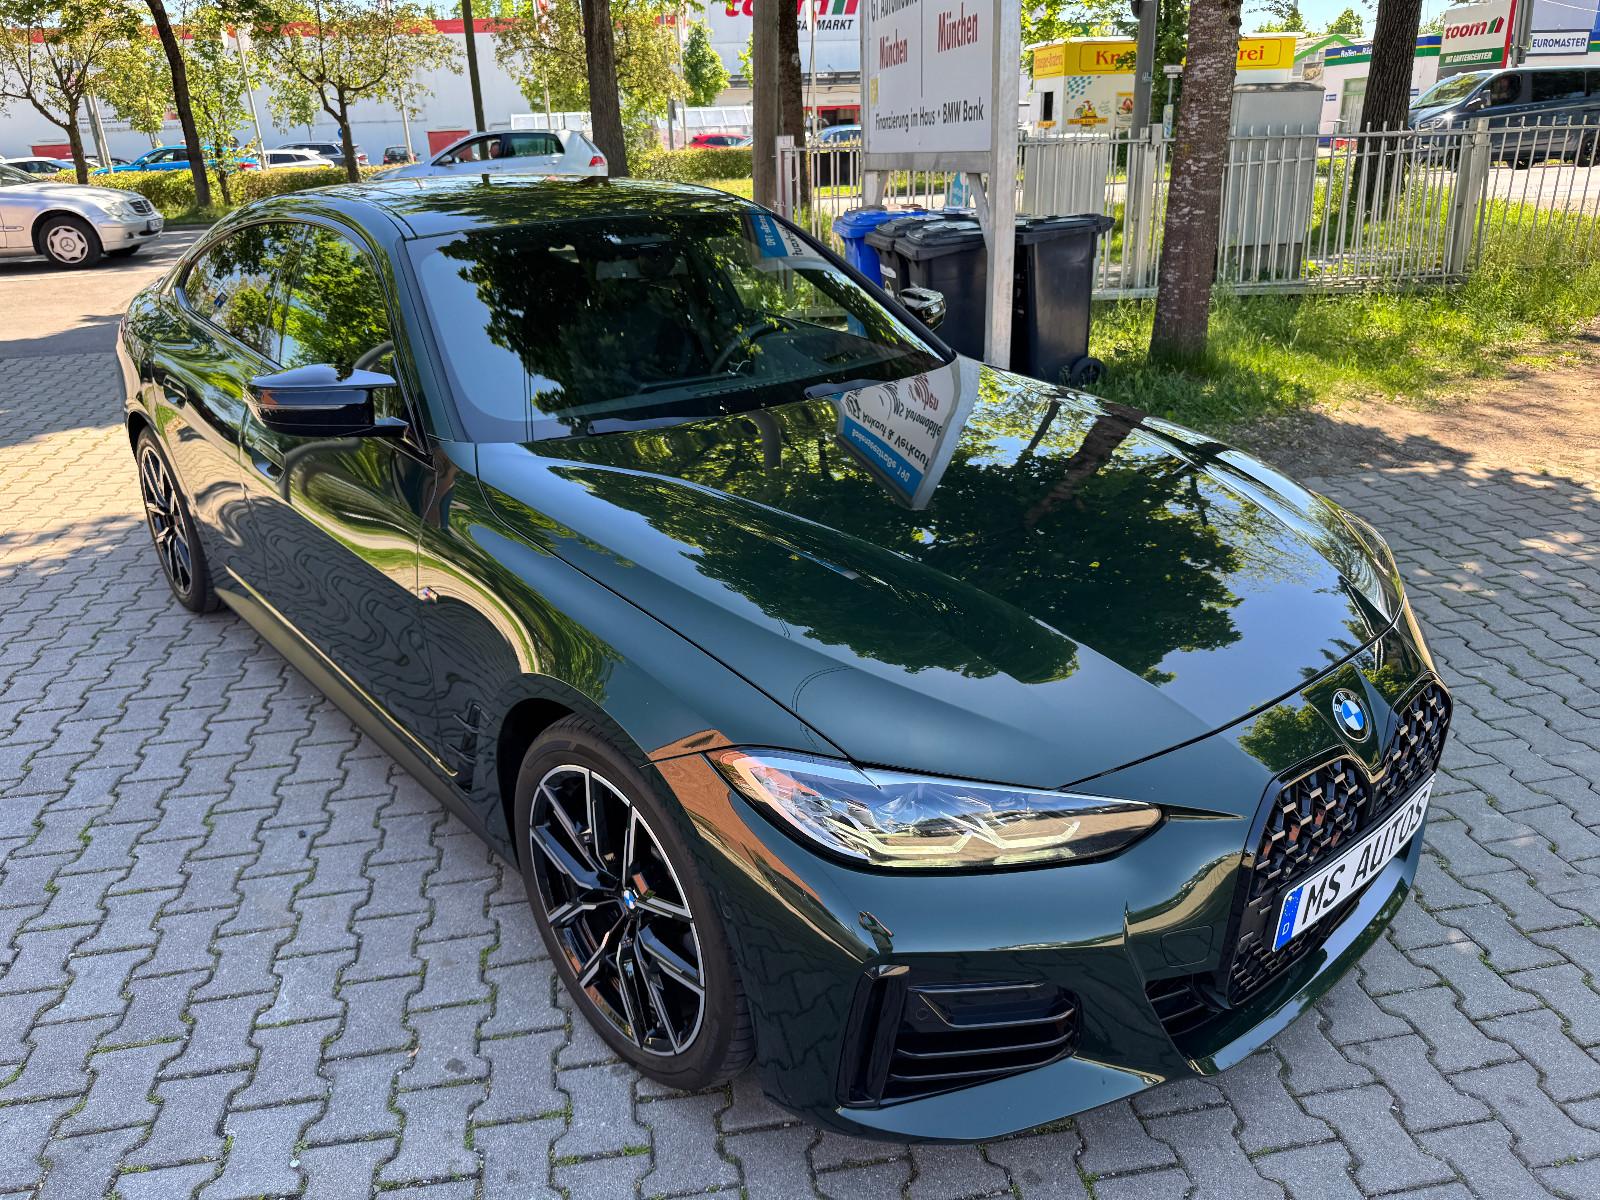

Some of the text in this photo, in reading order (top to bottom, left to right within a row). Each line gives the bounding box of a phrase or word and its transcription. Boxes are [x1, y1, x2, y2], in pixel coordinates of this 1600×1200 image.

[937, 1, 978, 53] München
[1445, 21, 1488, 40] toom
[1532, 37, 1586, 49] EUROMASTER
[879, 28, 908, 70] München
[875, 96, 984, 133] Finanzierung im Haus BMW Bank
[1301, 863, 1346, 926] MS
[1350, 789, 1428, 889] AUTOS
